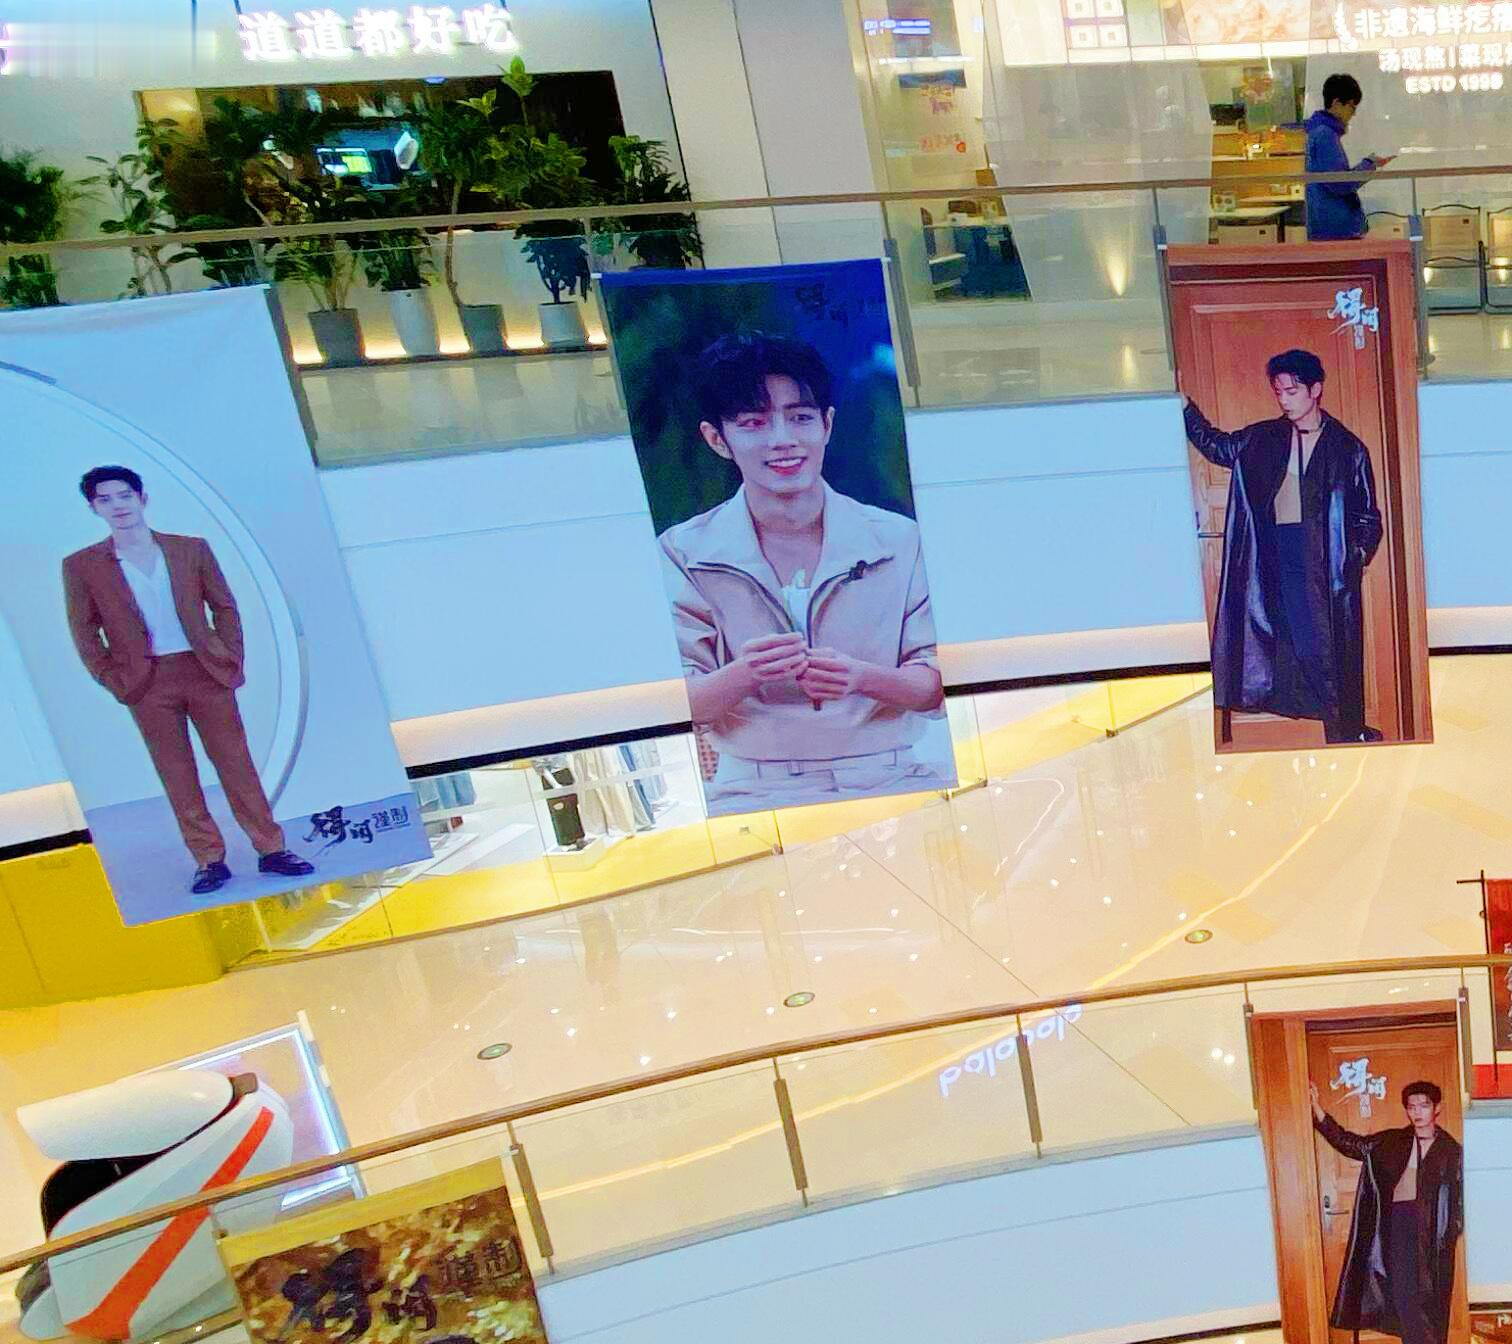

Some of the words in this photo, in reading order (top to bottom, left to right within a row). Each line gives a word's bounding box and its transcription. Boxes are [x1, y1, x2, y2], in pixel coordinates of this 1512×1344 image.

[239, 4, 520, 62] 道道都好吃
